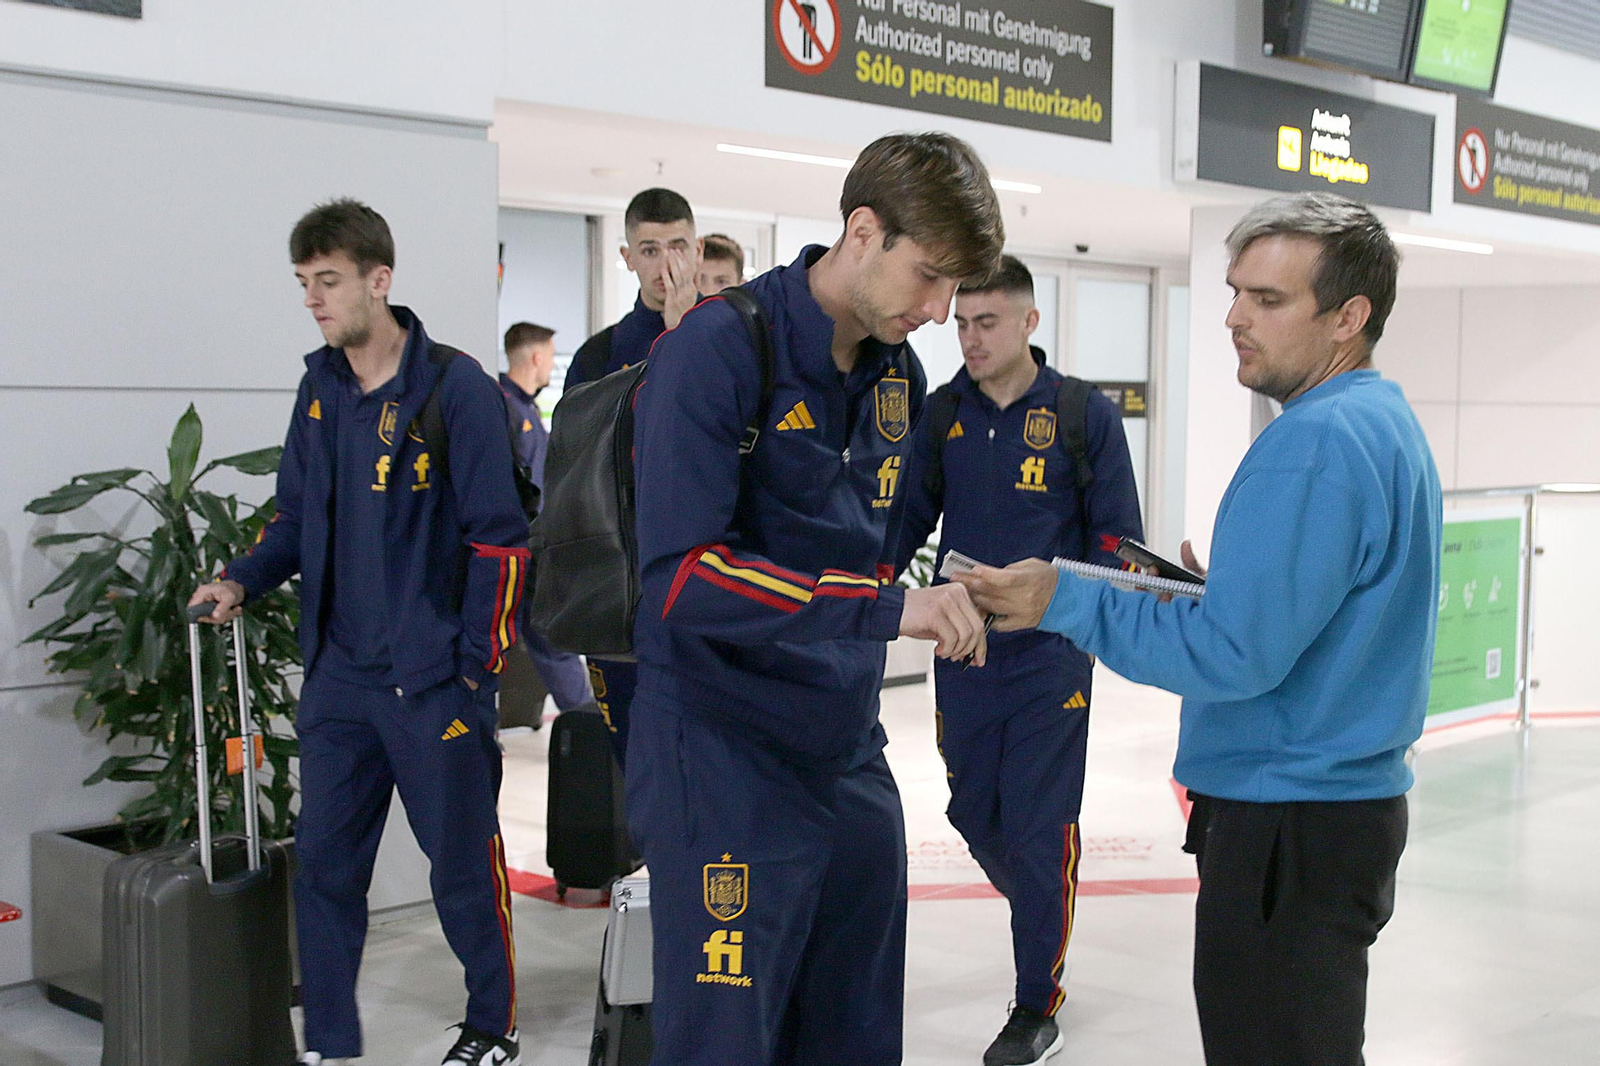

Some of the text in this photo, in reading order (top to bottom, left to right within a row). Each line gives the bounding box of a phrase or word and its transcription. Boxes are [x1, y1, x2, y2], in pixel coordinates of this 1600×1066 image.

[855, 14, 1054, 86] Authorized personnel only
[964, 8, 990, 35] mit
[993, 10, 1092, 61] Genehmigung
[856, 49, 1102, 123] Sólo personal autorizado
[703, 929, 743, 974] fi
[696, 973, 753, 987] network
